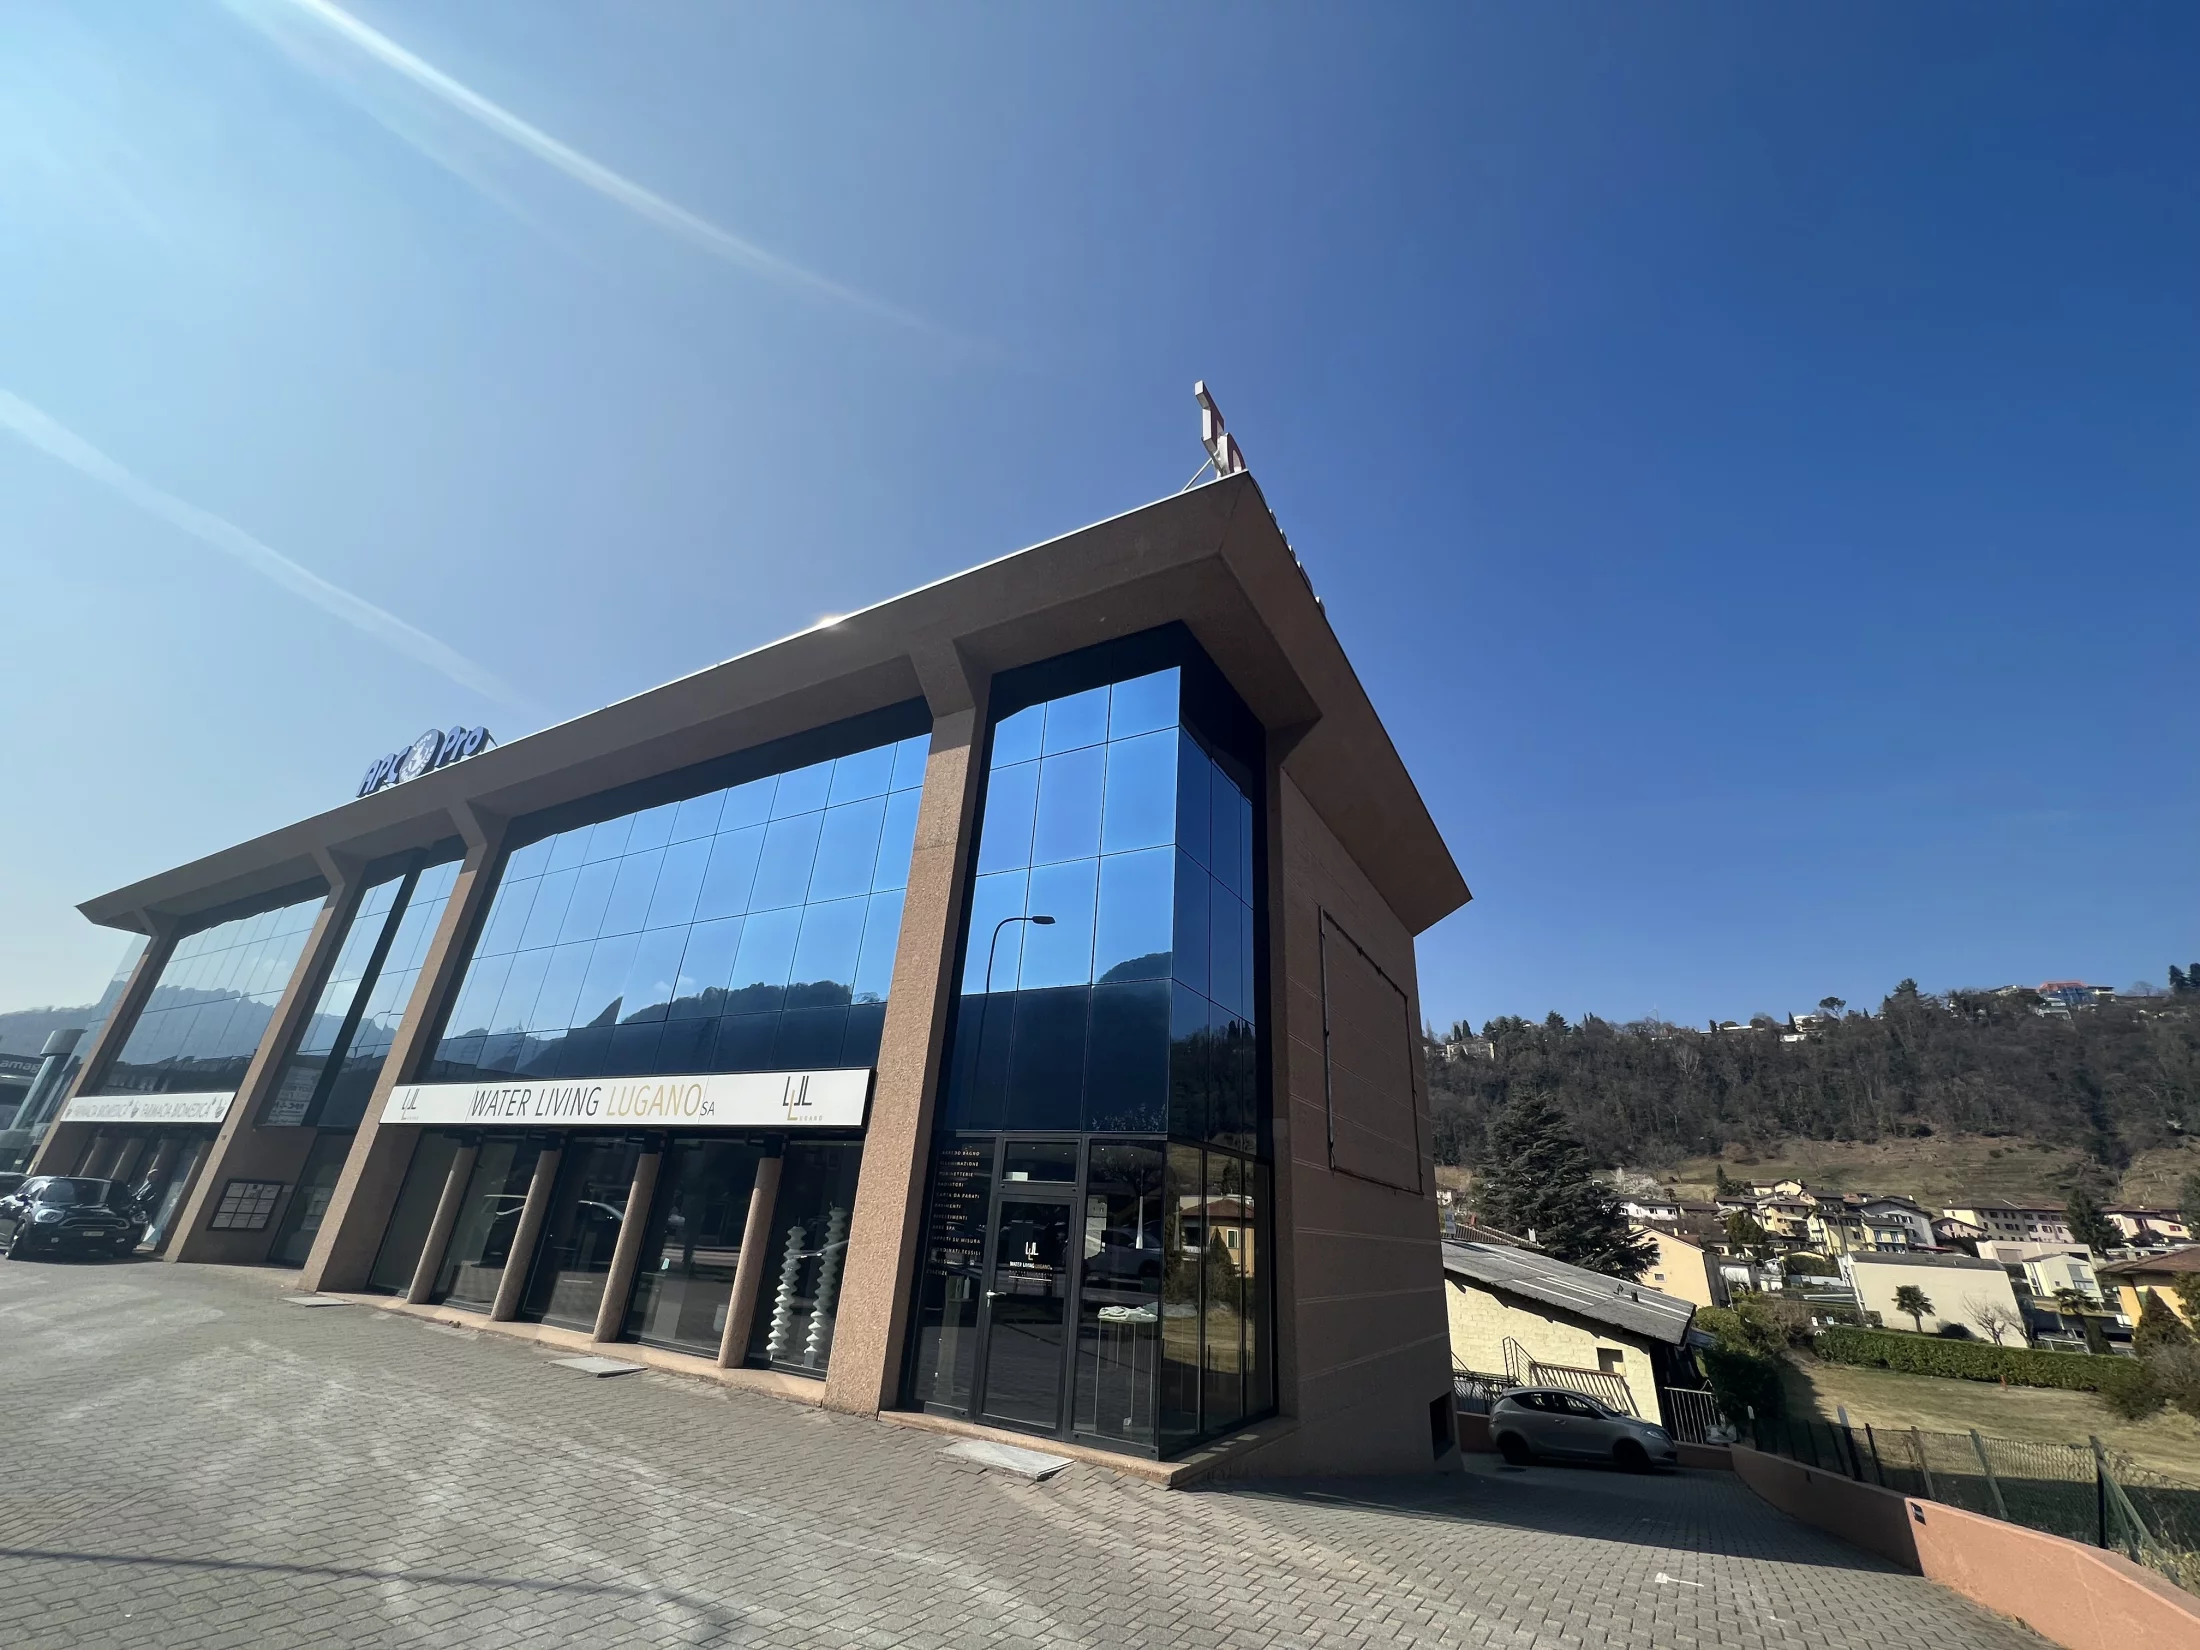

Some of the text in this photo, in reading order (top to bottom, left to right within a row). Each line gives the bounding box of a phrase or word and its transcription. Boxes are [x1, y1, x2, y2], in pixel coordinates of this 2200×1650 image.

[471, 1083, 715, 1117] WATER LIVING LUGANO SA
